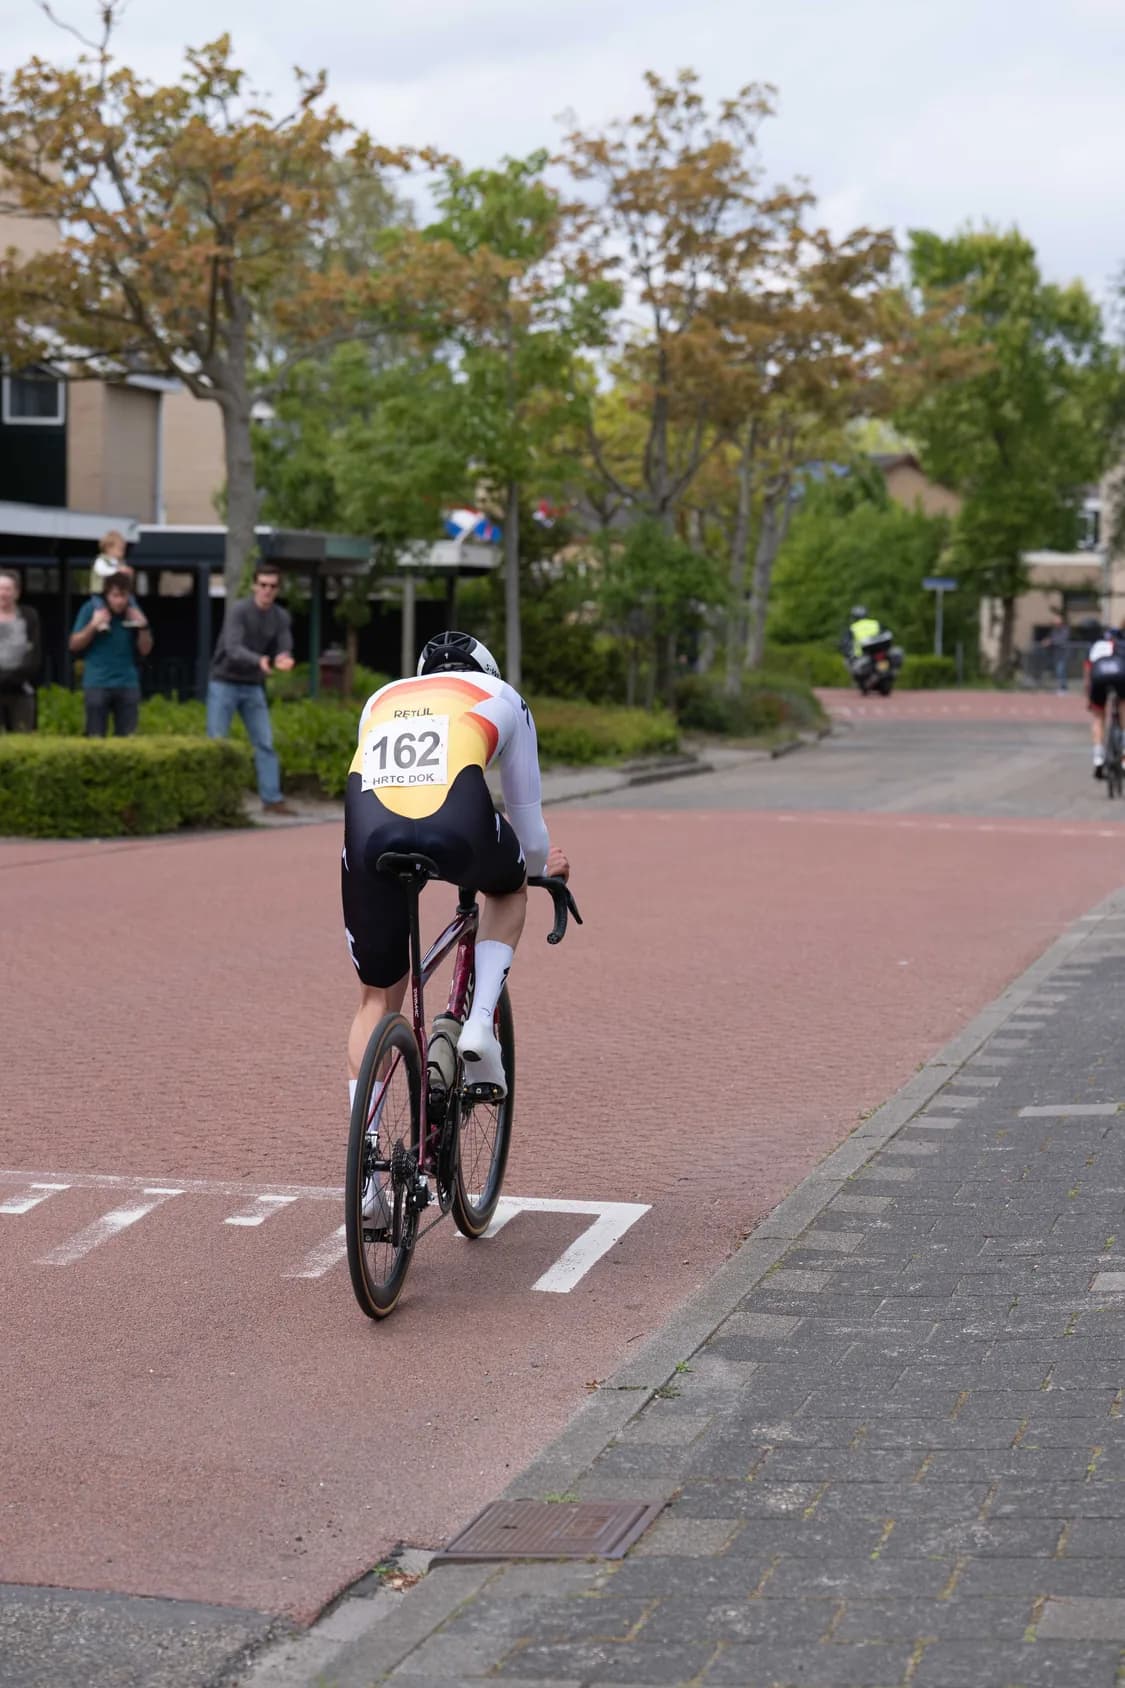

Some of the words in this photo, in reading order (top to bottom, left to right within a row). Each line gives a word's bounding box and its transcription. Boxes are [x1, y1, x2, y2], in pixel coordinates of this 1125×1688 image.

[372, 731, 440, 770] 162
[373, 775, 405, 785] HRTC
[408, 773, 434, 783] DOK
